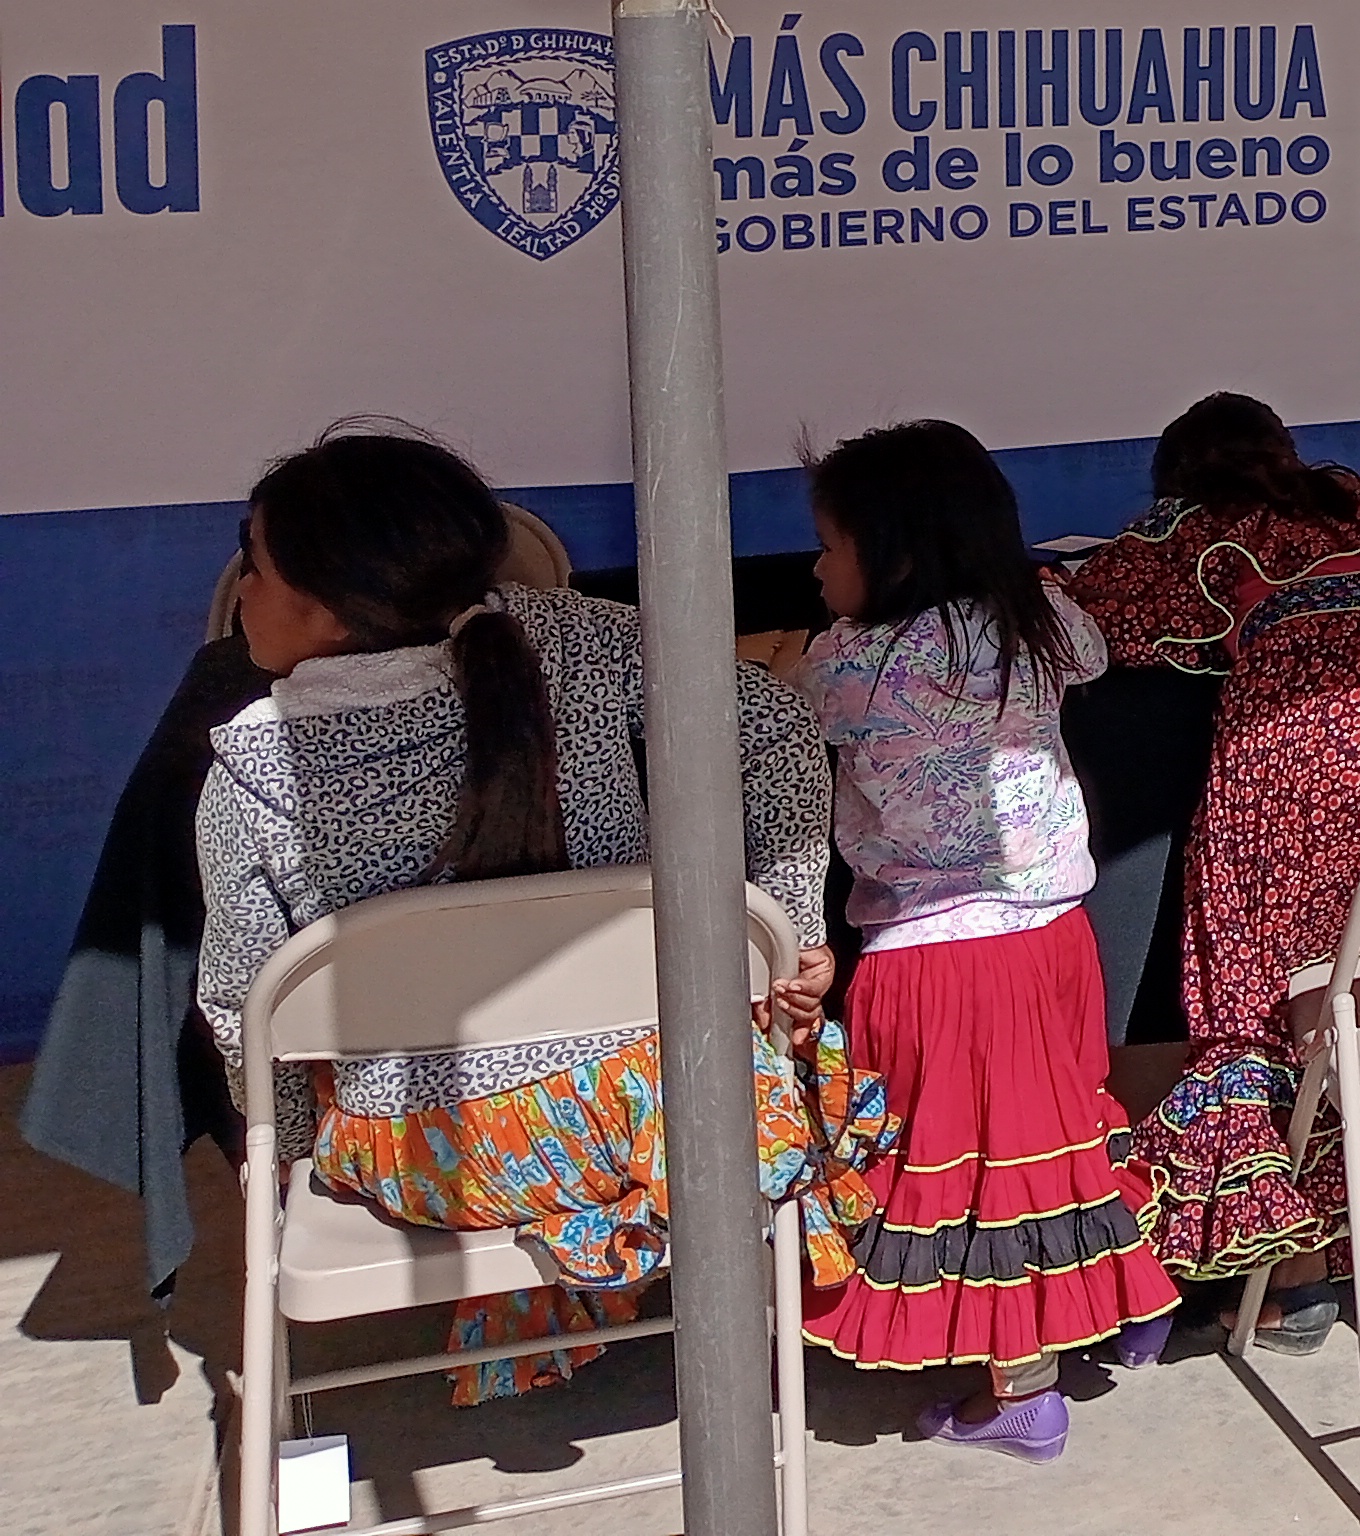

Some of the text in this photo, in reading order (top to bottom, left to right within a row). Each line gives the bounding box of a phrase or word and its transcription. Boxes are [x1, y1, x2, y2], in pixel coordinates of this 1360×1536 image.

[891, 24, 1328, 133] CHIHUAHUA
[433, 88, 484, 209] VALENTIA
[881, 135, 979, 192] de
[1004, 132, 1074, 187] lo
[1099, 129, 1331, 184] bueno
[496, 218, 582, 258] LEALTAD
[1009, 197, 1107, 238] DEL
[1126, 188, 1328, 232] ESTADO
